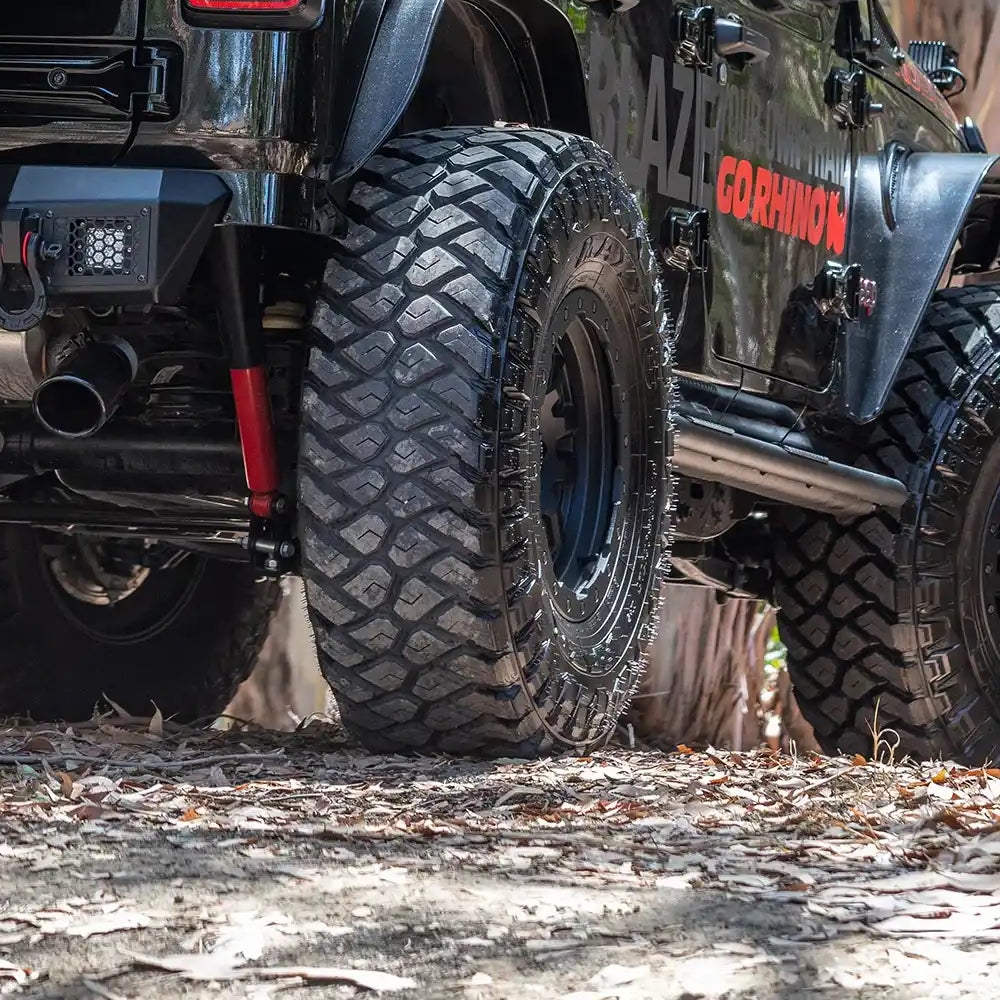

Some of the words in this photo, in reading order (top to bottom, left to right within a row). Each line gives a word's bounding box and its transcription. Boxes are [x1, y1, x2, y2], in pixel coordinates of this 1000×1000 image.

[588, 30, 720, 211] BLAZE
[716, 155, 753, 220] GO
[752, 166, 827, 246] RHINO
